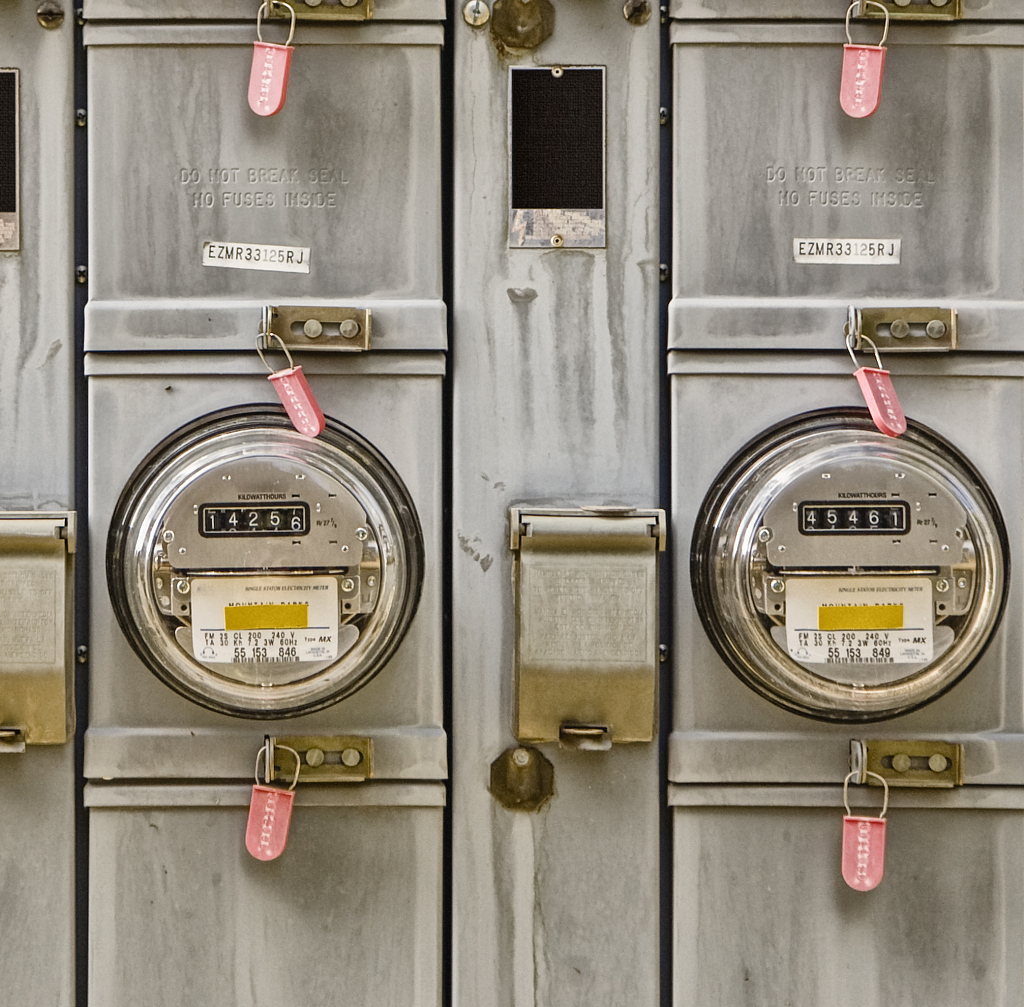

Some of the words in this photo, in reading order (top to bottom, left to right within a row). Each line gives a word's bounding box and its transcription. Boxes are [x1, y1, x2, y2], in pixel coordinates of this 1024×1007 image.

[180, 168, 200, 184] DO
[767, 167, 786, 183] DO
[222, 193, 275, 208] FUSES
[809, 191, 861, 207] FUSES
[208, 245, 304, 264] EZMR33125RJ
[799, 242, 894, 257] EZMR33125RJ
[210, 512, 300, 530] 14256
[807, 510, 898, 526] 45461
[234, 648, 245, 657] 55
[253, 648, 267, 657] 153
[279, 648, 296, 657] 846
[828, 648, 839, 658] 55
[847, 648, 861, 658] 153
[873, 648, 890, 658] 849
